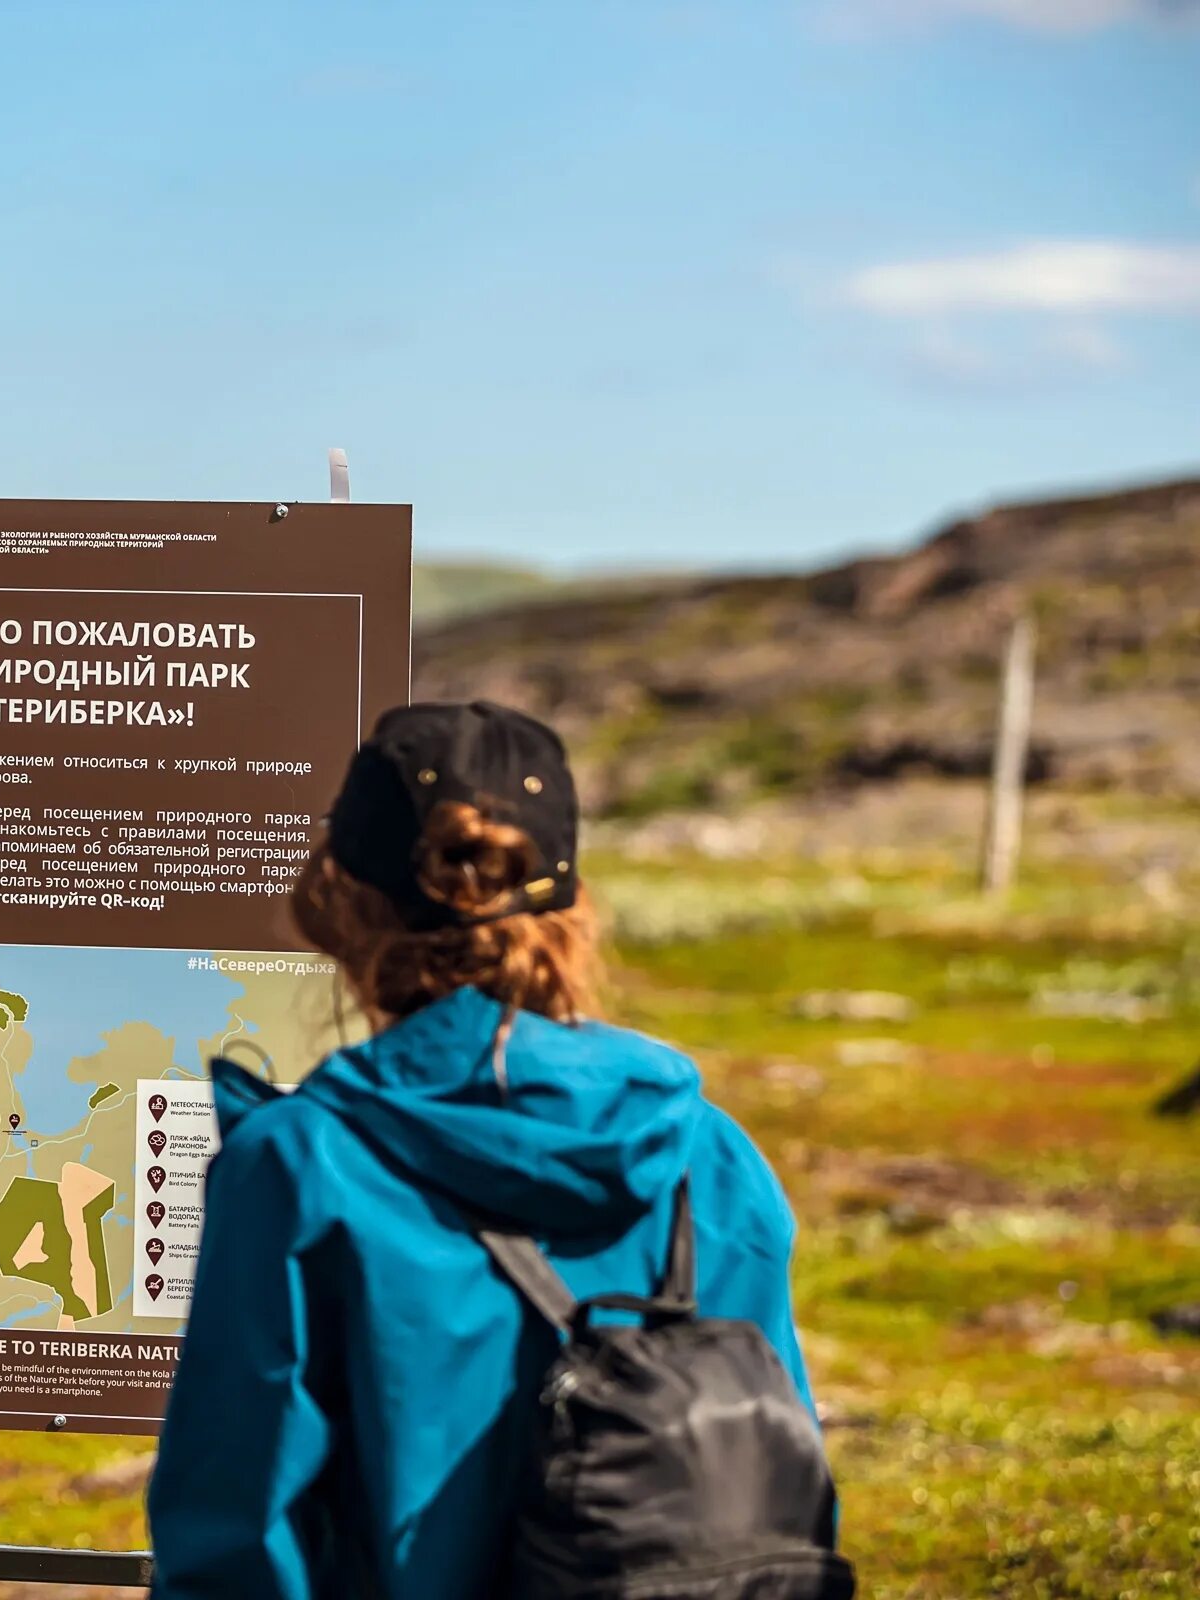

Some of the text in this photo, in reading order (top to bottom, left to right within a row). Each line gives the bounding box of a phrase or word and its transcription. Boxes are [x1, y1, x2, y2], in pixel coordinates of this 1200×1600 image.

[69, 540, 115, 548] ПРИРОДНЫХ
[116, 540, 164, 548] ТЕРРИТОРИЙ
[86, 532, 128, 540] ХОЗЯЙСТВА
[130, 533, 181, 541] МУРМАНСКОЙ
[183, 534, 217, 542] ОБЛАСТИ
[33, 620, 256, 649] ПОЖАЛОВАТЬ
[166, 662, 250, 688] ПАРК
[63, 756, 148, 769] относиться
[158, 759, 166, 769] к
[174, 758, 237, 773] хрупкой
[246, 760, 312, 775] природе
[44, 807, 143, 822] посещением
[157, 810, 252, 825] природного
[265, 813, 311, 828] парка
[101, 827, 108, 837] с
[119, 827, 206, 840] правилами
[217, 829, 310, 843] посещения.
[84, 842, 101, 854] об
[108, 842, 210, 857] обязательной
[217, 847, 310, 862] регистрации
[42, 859, 138, 873] посещением
[154, 862, 245, 877] природного
[46, 876, 69, 888] это
[74, 878, 124, 889] можно
[129, 879, 136, 890] с
[140, 880, 215, 894] помощью
[220, 880, 294, 897] смартфон
[187, 957, 336, 976] #НаСевереОтдыха
[12, 1340, 35, 1355] TO
[40, 1341, 133, 1359] TERIBERKA
[138, 1345, 182, 1361] NATU
[2, 1363, 12, 1372] be
[14, 1364, 45, 1373] mindful
[47, 1365, 55, 1373] of
[57, 1366, 69, 1374] the
[72, 1367, 123, 1376] environment
[137, 1369, 150, 1378] the
[152, 1370, 169, 1378] Kola
[4, 1374, 13, 1382] of
[14, 1375, 27, 1383] the
[29, 1376, 57, 1384] Nature
[59, 1377, 77, 1385] Park
[79, 1378, 105, 1386] before
[107, 1380, 125, 1388] your
[127, 1380, 143, 1388] visit
[145, 1380, 160, 1388] and
[37, 1386, 43, 1394] is
[52, 1387, 103, 1397] smartphone.
